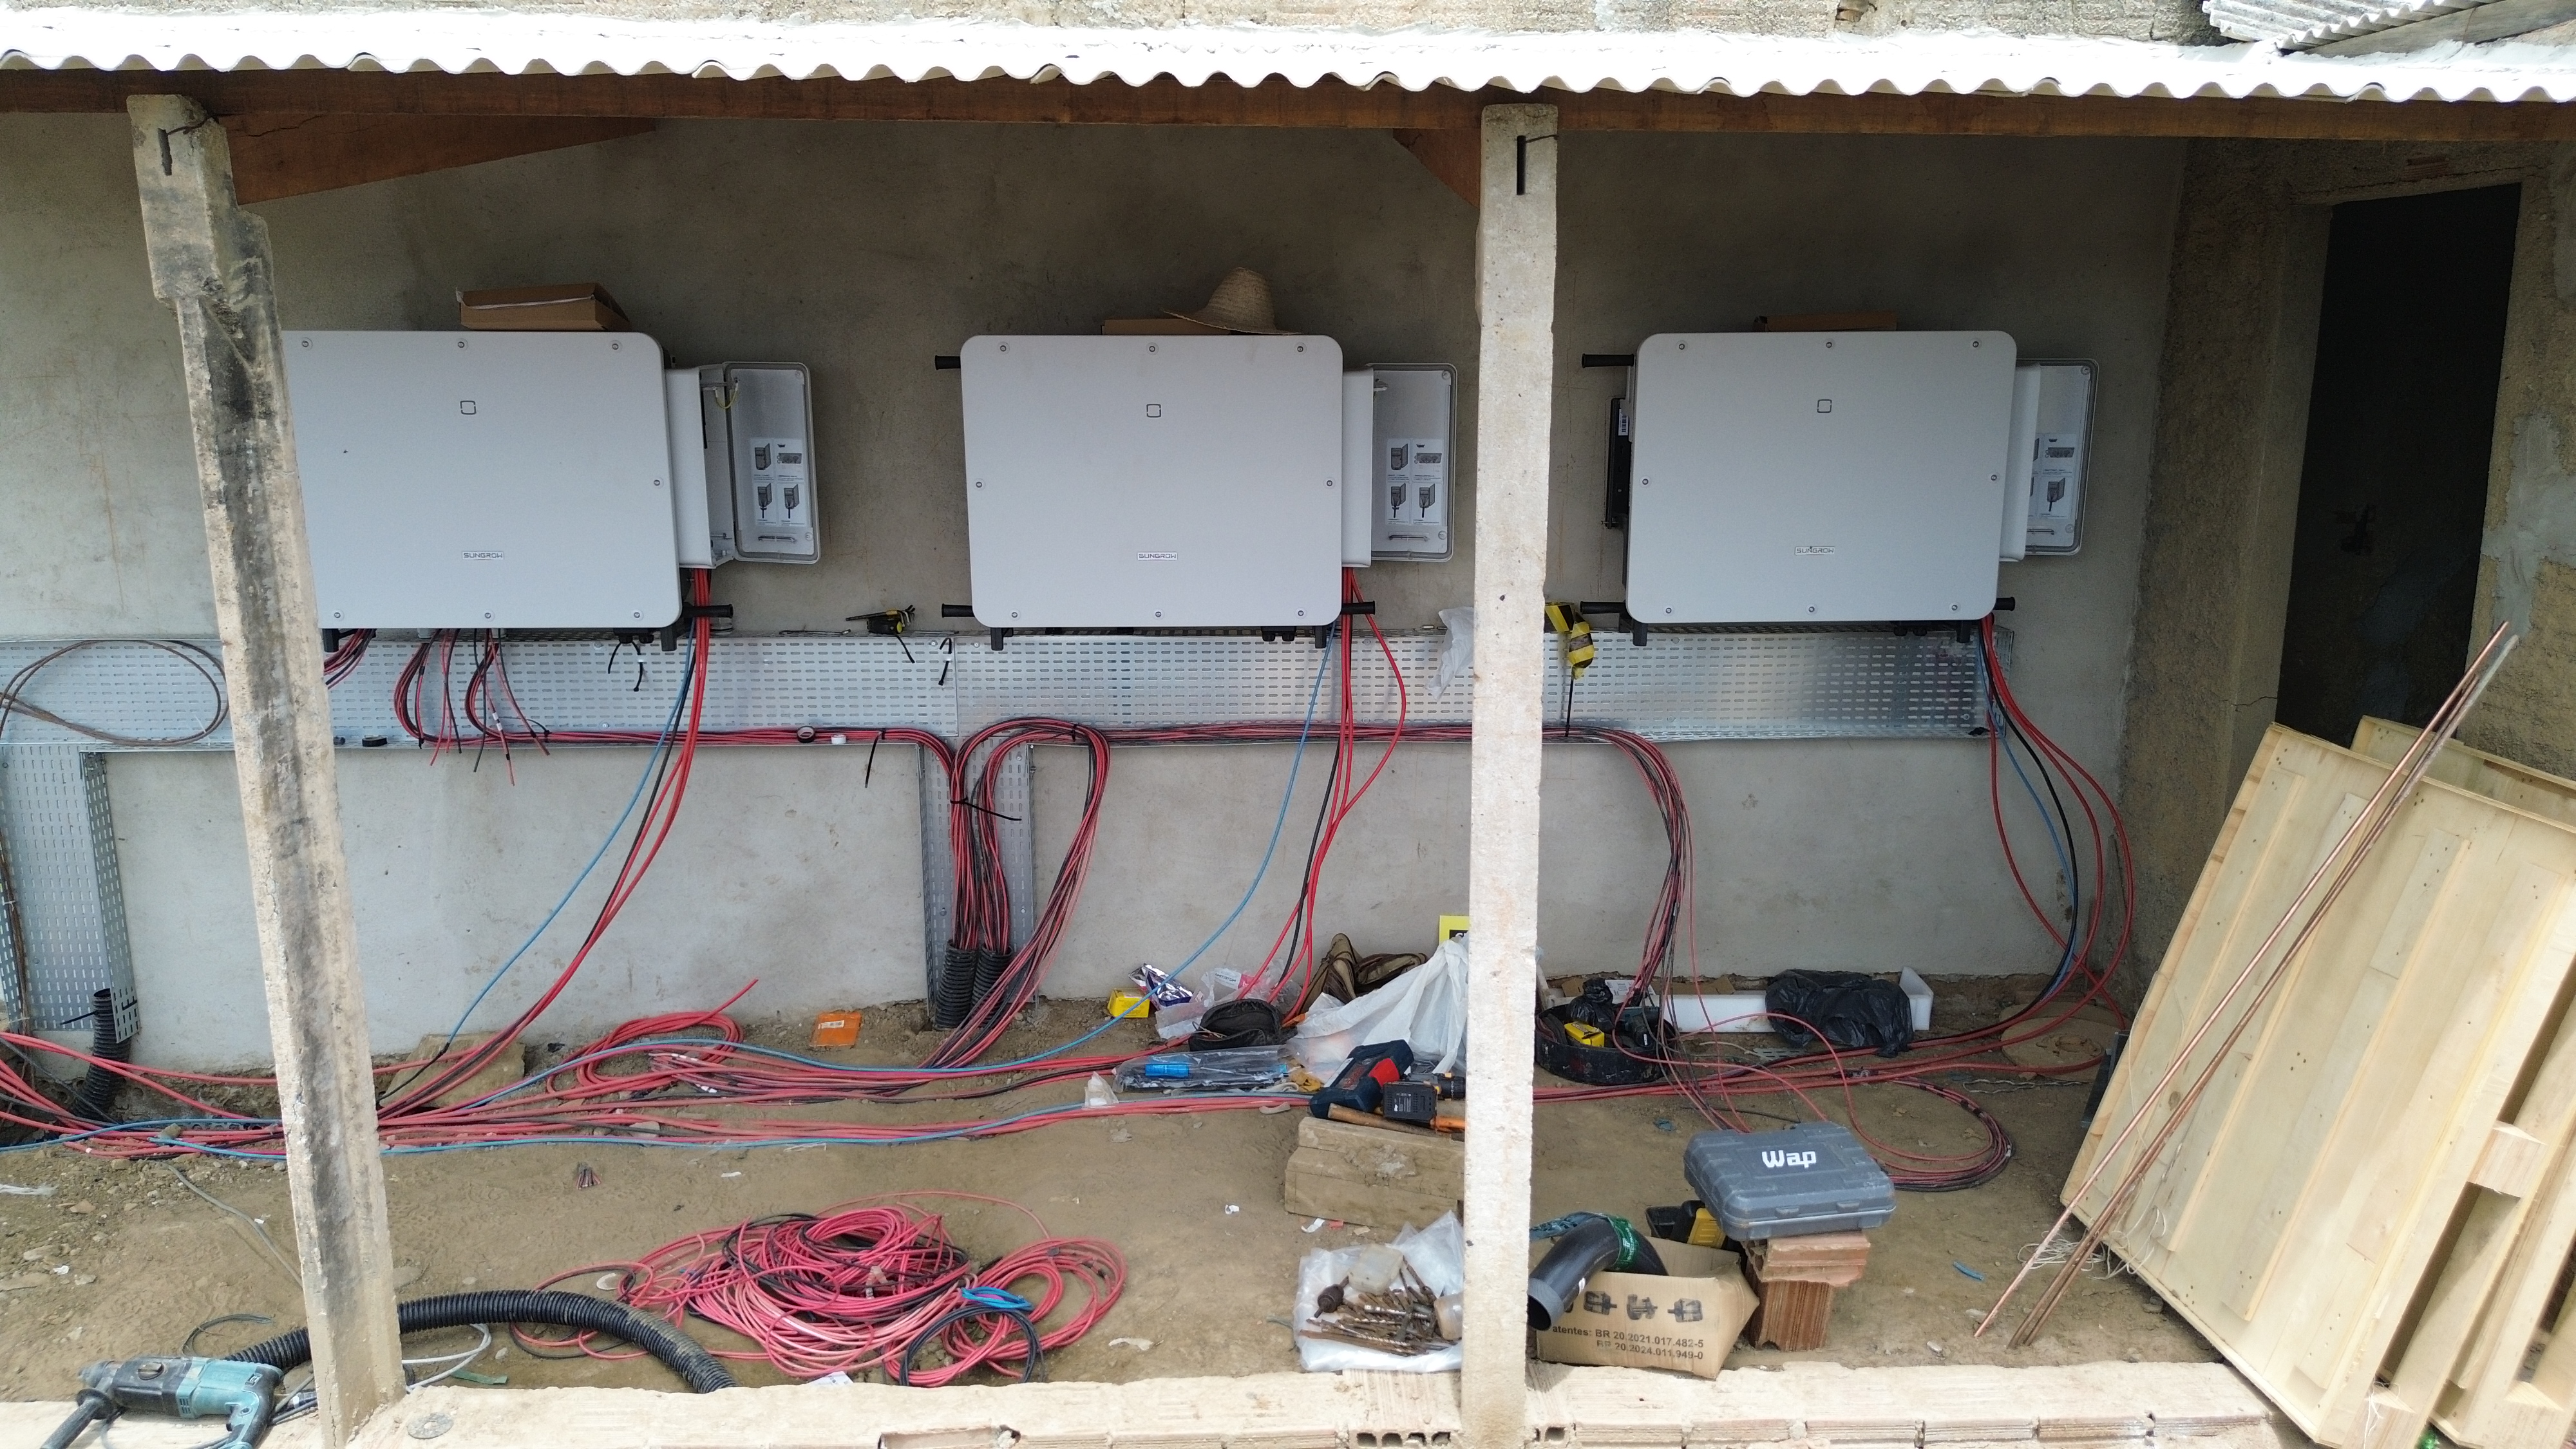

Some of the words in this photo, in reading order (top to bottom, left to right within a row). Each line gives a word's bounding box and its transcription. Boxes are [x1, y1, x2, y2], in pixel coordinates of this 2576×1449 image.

[1761, 1150, 1817, 1168] Wap
[1552, 1325, 1592, 1336] atentes:
[1595, 1329, 1611, 1338] BR
[1613, 1331, 1704, 1348] 20.2021.017.482-5
